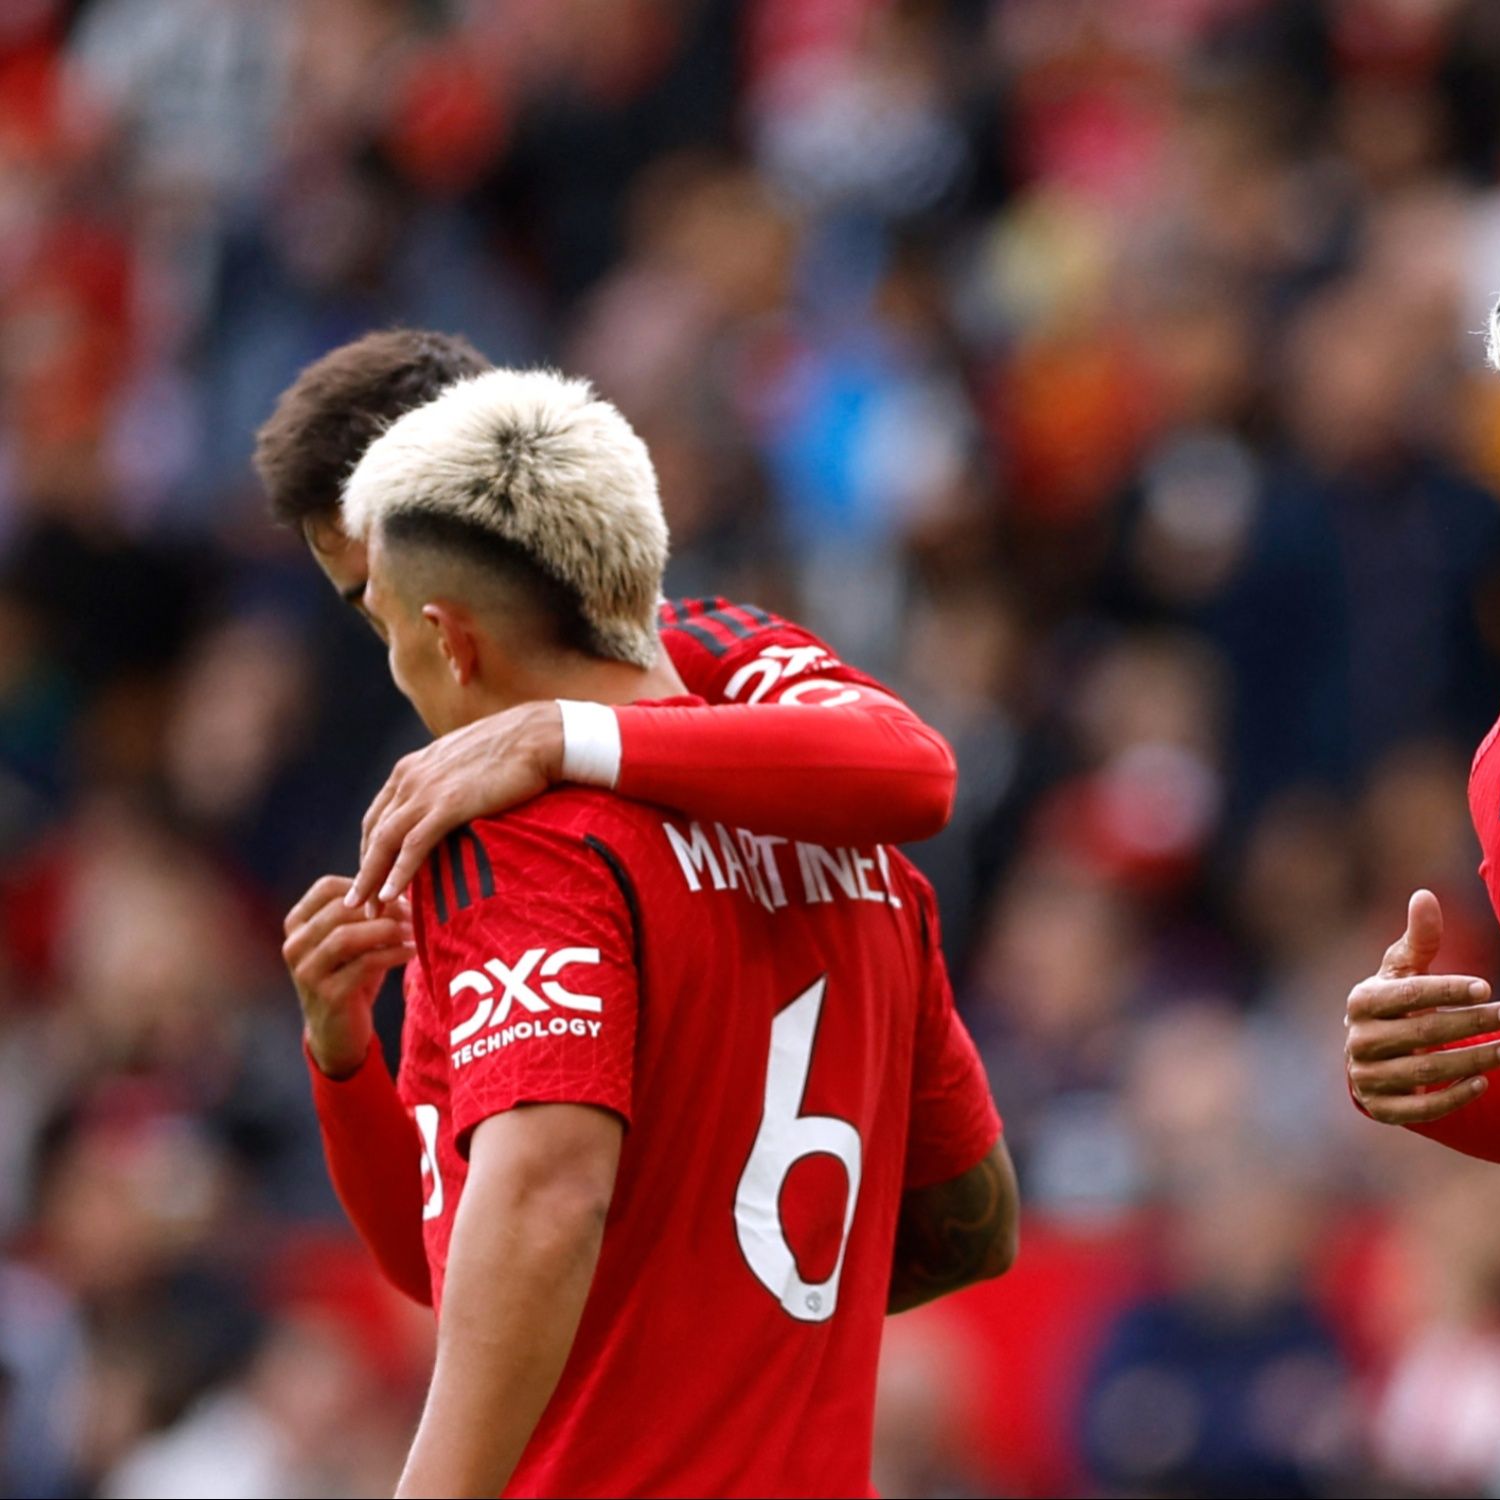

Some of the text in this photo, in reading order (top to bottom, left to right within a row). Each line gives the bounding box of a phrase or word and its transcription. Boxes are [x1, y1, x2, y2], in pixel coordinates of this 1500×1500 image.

[449, 947, 603, 1046] DXC
[451, 1017, 602, 1070] TECHNOLOGY
[733, 973, 862, 1323] 6
